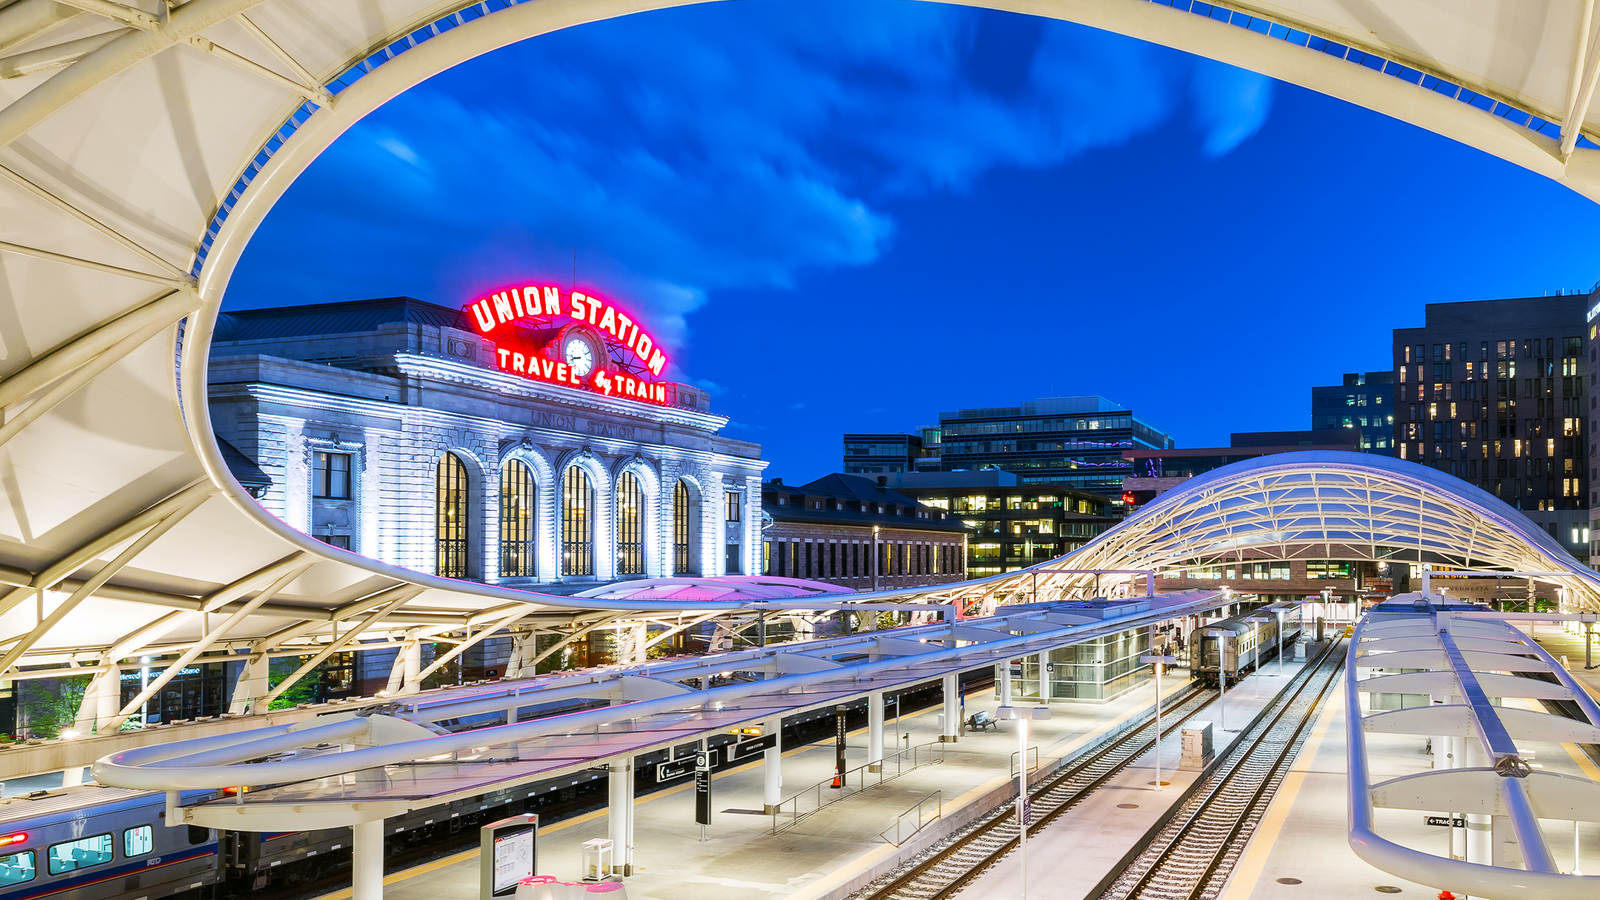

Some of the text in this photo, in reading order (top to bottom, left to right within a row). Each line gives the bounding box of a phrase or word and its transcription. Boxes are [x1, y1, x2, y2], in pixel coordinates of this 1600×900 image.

[472, 286, 666, 376] UNION STATION
[497, 348, 665, 402] TRAVEL by TRAIN
[531, 410, 635, 439] UNION STATION
